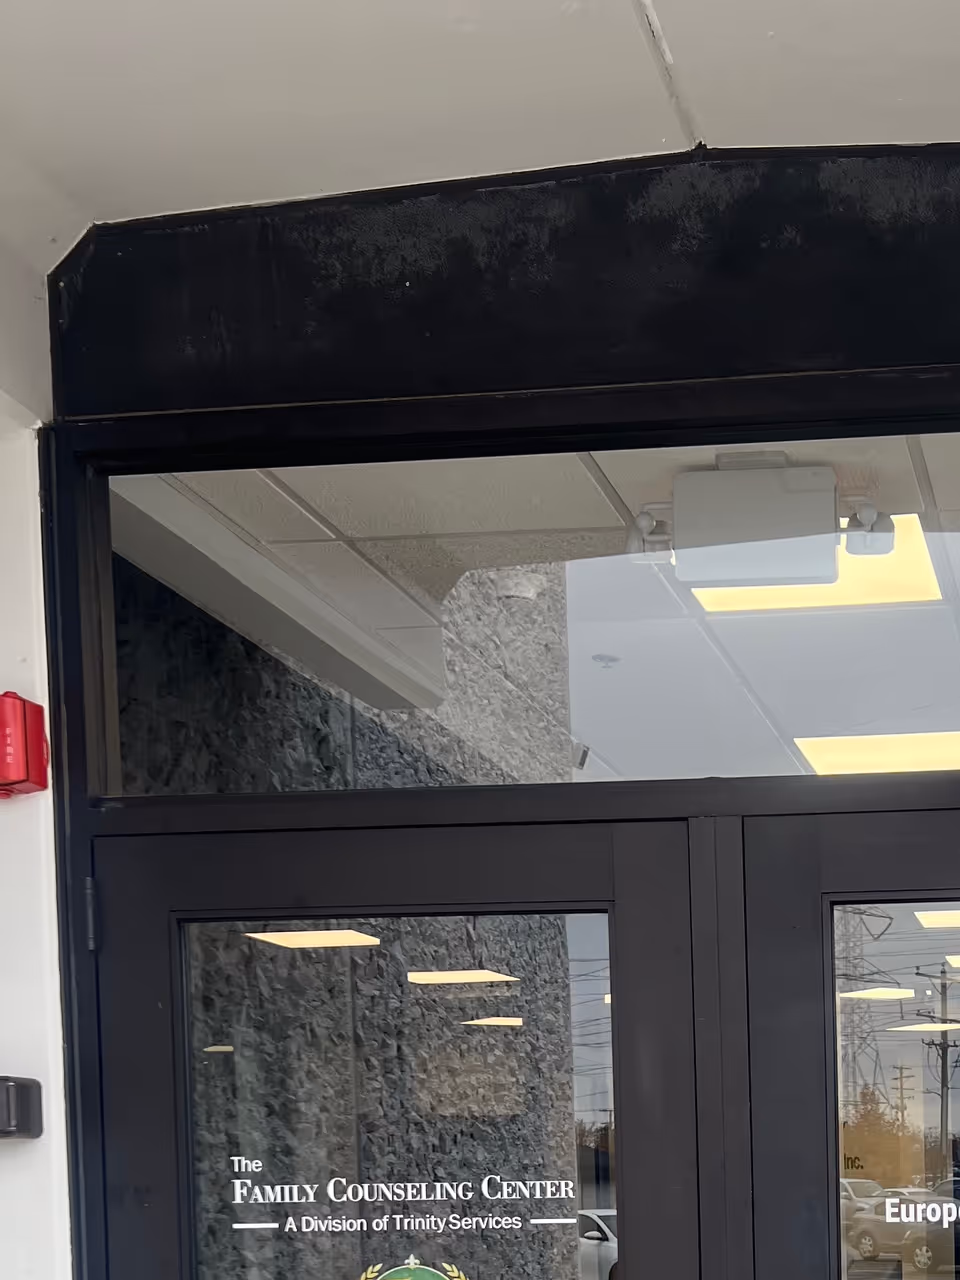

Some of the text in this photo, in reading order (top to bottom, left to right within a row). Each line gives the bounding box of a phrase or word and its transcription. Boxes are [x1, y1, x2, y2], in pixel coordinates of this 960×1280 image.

[230, 1156, 263, 1172] The
[231, 1175, 575, 1204] FAMILY COUNSELING CENTER
[284, 1213, 522, 1233] A Division of Trinity Services
